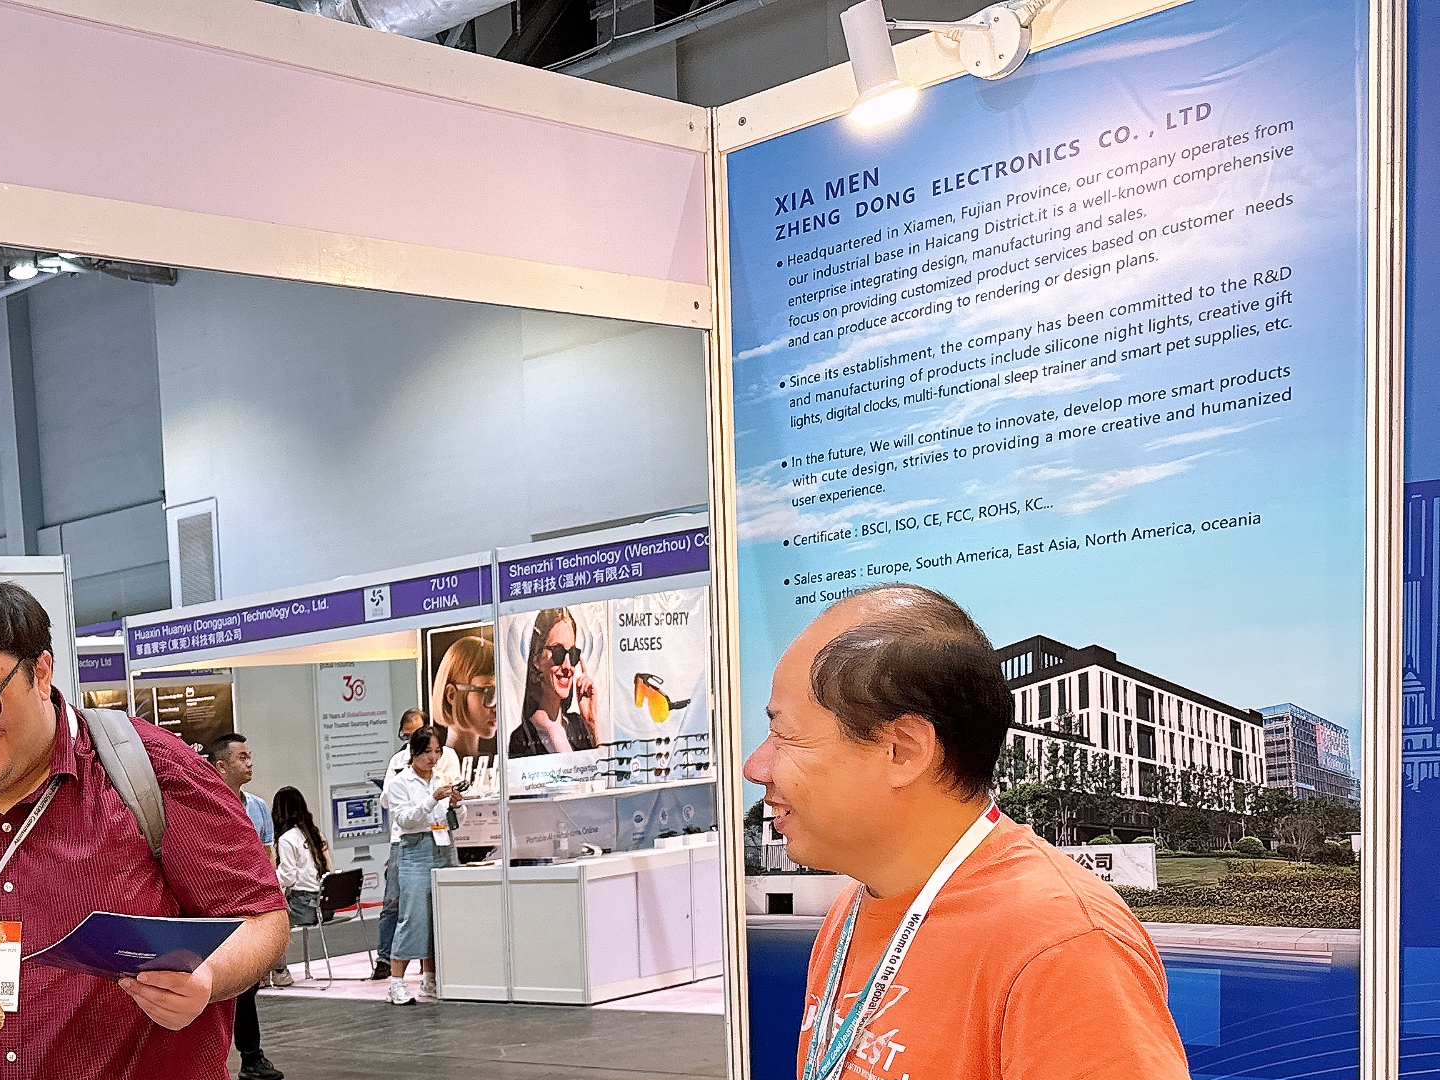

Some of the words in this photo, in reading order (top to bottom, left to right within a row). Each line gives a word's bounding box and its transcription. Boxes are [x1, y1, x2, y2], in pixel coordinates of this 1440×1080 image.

[774, 187, 815, 217] XIA
[825, 166, 879, 201] MEN
[775, 208, 840, 242] ZHENG
[855, 186, 915, 219] DONG
[932, 138, 1080, 197] ELECTRONICS
[1166, 102, 1212, 131] LTD
[787, 228, 882, 267] Headquartered
[887, 226, 899, 240] in
[903, 213, 956, 235] Xiamen,
[961, 200, 1002, 220] Fujian
[1006, 182, 1071, 207] Province,
[1076, 172, 1102, 188] our
[1106, 152, 1177, 180] company
[1181, 131, 1250, 161] operates
[1254, 120, 1294, 140] from
[788, 284, 847, 307] enterprise
[850, 265, 918, 292] integrating
[921, 254, 968, 273] design,
[972, 226, 1071, 261] manufacturing
[1076, 214, 1103, 234] and
[1107, 208, 1147, 226] sales.
[789, 373, 821, 388] Since
[824, 368, 839, 381] its
[842, 346, 936, 377] establishment,
[940, 340, 963, 355] the
[967, 325, 1033, 349] company
[1037, 319, 1062, 334] has
[1067, 310, 1104, 327] been
[1109, 286, 1193, 318] committed
[1198, 285, 1215, 298] to
[1220, 278, 1248, 294] the
[1253, 266, 1292, 287] R&D
[791, 456, 803, 468] In
[805, 452, 825, 465] the
[827, 446, 866, 462] future,
[869, 439, 890, 453] We
[893, 432, 914, 449] will
[917, 425, 974, 445] continue
[976, 421, 992, 434] to
[995, 409, 1059, 430] innovate,
[1063, 397, 1123, 417] develop
[1127, 389, 1167, 406] more
[1171, 378, 1215, 398] smart
[1219, 365, 1291, 393] products
[791, 494, 817, 508] user
[819, 483, 886, 504] experience.
[793, 528, 852, 547] Certificate
[861, 520, 892, 537] BSCI,
[895, 516, 920, 532] ISO,
[923, 513, 943, 527] CE,
[946, 508, 975, 524] FCC,
[978, 501, 1021, 519] ROHS,
[509, 559, 554, 578] Shenzhi
[556, 549, 621, 570] Technology
[624, 535, 691, 562] (Wenzhou)
[793, 572, 823, 586] Sales
[825, 568, 857, 582] areas
[867, 562, 912, 576] Europe,
[915, 553, 953, 570] South
[955, 546, 1013, 565] America,
[1017, 541, 1045, 556] East
[1048, 536, 1080, 552] Asia,
[1085, 529, 1127, 547] North
[1130, 521, 1196, 541] America,
[1201, 511, 1261, 532] oceania
[423, 594, 459, 611] CHINA
[429, 576, 459, 592] 7U10
[134, 628, 161, 641] Huaxin
[162, 624, 192, 639] Huanyu
[193, 612, 241, 633] (Dongguan)
[242, 605, 290, 624] Technology
[312, 598, 329, 611] Ltd.
[619, 612, 652, 627] SMART
[78, 657, 99, 668] actory
[619, 636, 663, 652] GLASSES
[894, 913, 922, 954] Welcome
[880, 965, 896, 981] the
[888, 954, 901, 965] to
[868, 981, 886, 1011] global
